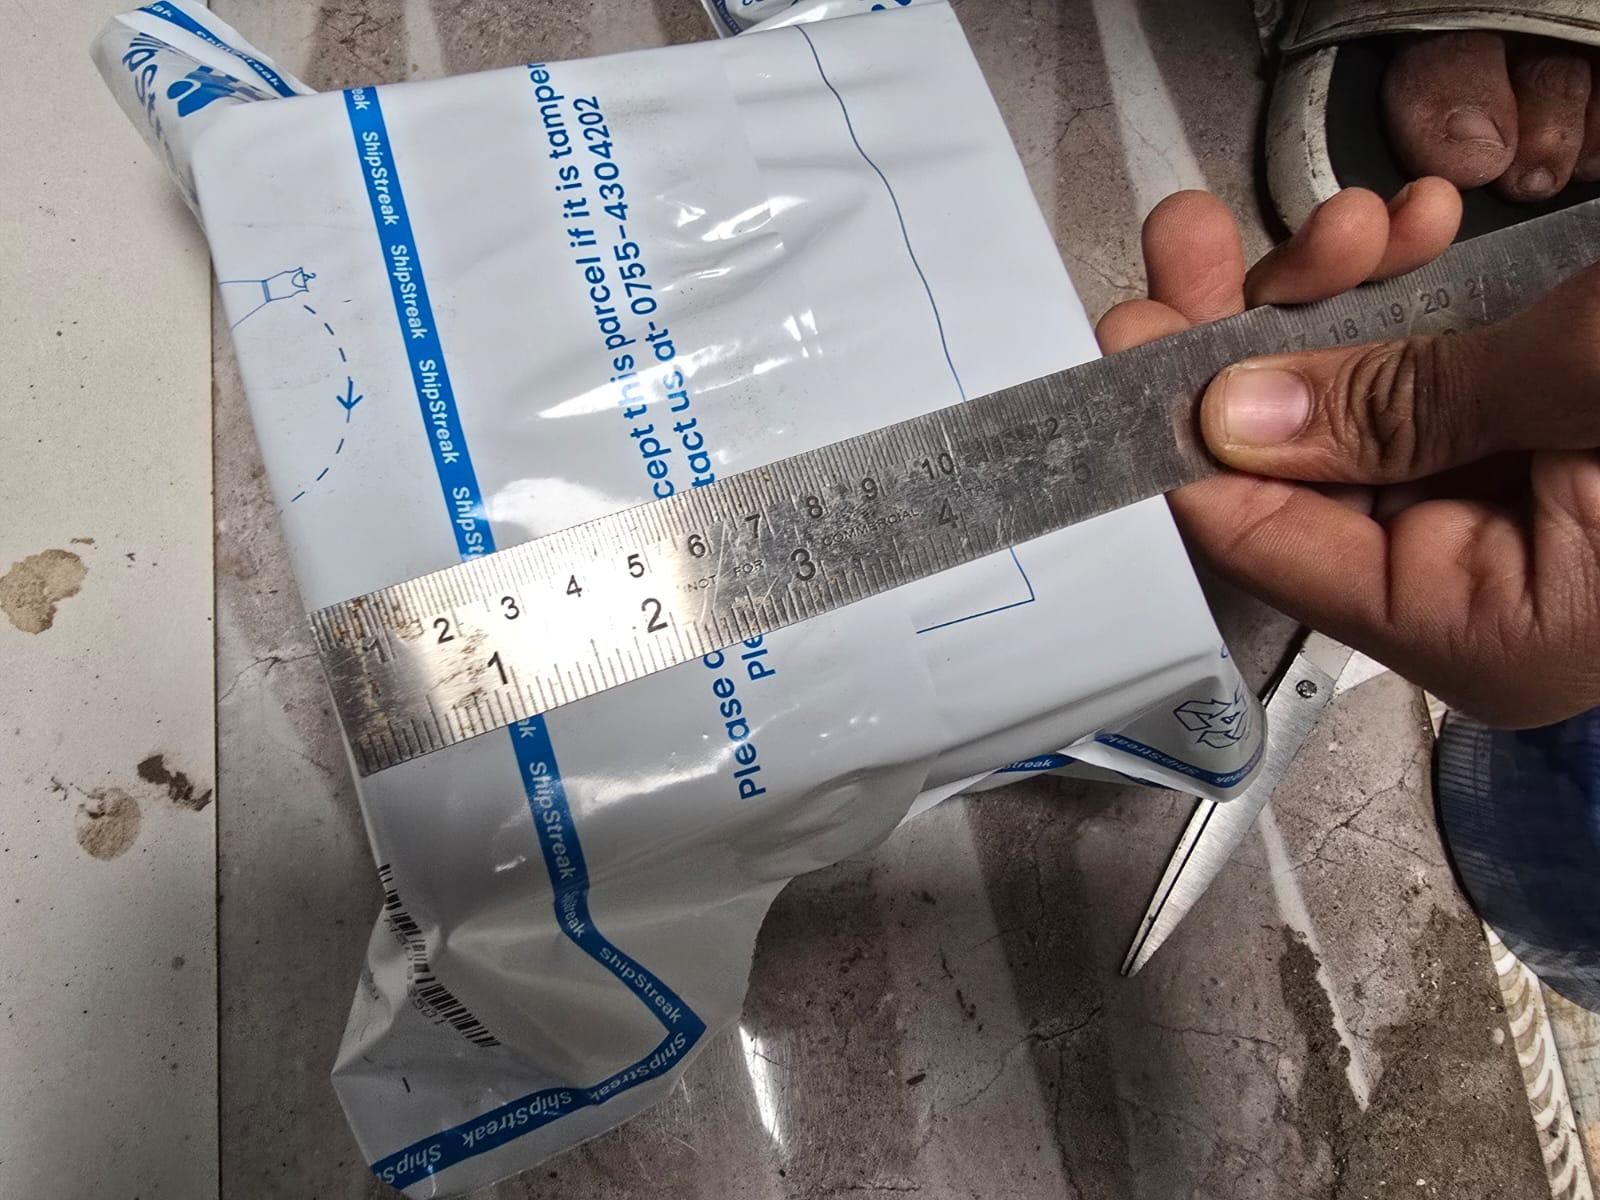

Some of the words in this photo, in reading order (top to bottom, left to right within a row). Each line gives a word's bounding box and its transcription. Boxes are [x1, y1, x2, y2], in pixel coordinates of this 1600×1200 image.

[528, 63, 572, 159] tamper
[556, 165, 583, 191] is
[563, 198, 590, 218] it
[567, 228, 597, 247] if
[362, 132, 399, 225] ShipStreak
[391, 244, 427, 339] ShipStreak
[419, 359, 459, 464] ShipStreak
[575, 257, 637, 350] parcel
[610, 354, 647, 419] this
[663, 368, 690, 412] us
[433, 617, 454, 643] 2
[501, 596, 519, 620] 3
[566, 574, 583, 598] 4
[627, 554, 645, 578] 5
[688, 534, 706, 558] 6
[745, 514, 761, 538] 7
[806, 496, 823, 519] 8
[861, 477, 878, 500] 9
[921, 452, 955, 480] 10
[1329, 318, 1358, 344] 18
[1376, 303, 1404, 328] 19
[1420, 287, 1450, 315] 20
[631, 424, 675, 499] cept
[673, 418, 715, 487] tact
[687, 574, 717, 592] NOT
[733, 559, 764, 577] FOR
[822, 509, 920, 546] COMMERCIAL
[487, 651, 508, 685] 1
[640, 598, 668, 633] 2
[791, 548, 817, 581] 3
[937, 498, 958, 529] 4
[713, 677, 766, 800] Please
[529, 761, 577, 880] ShipStreak
[599, 946, 682, 1024] ShipStreak
[587, 1031, 688, 1101] ShipStreak
[461, 1092, 572, 1149] ShipStreak
